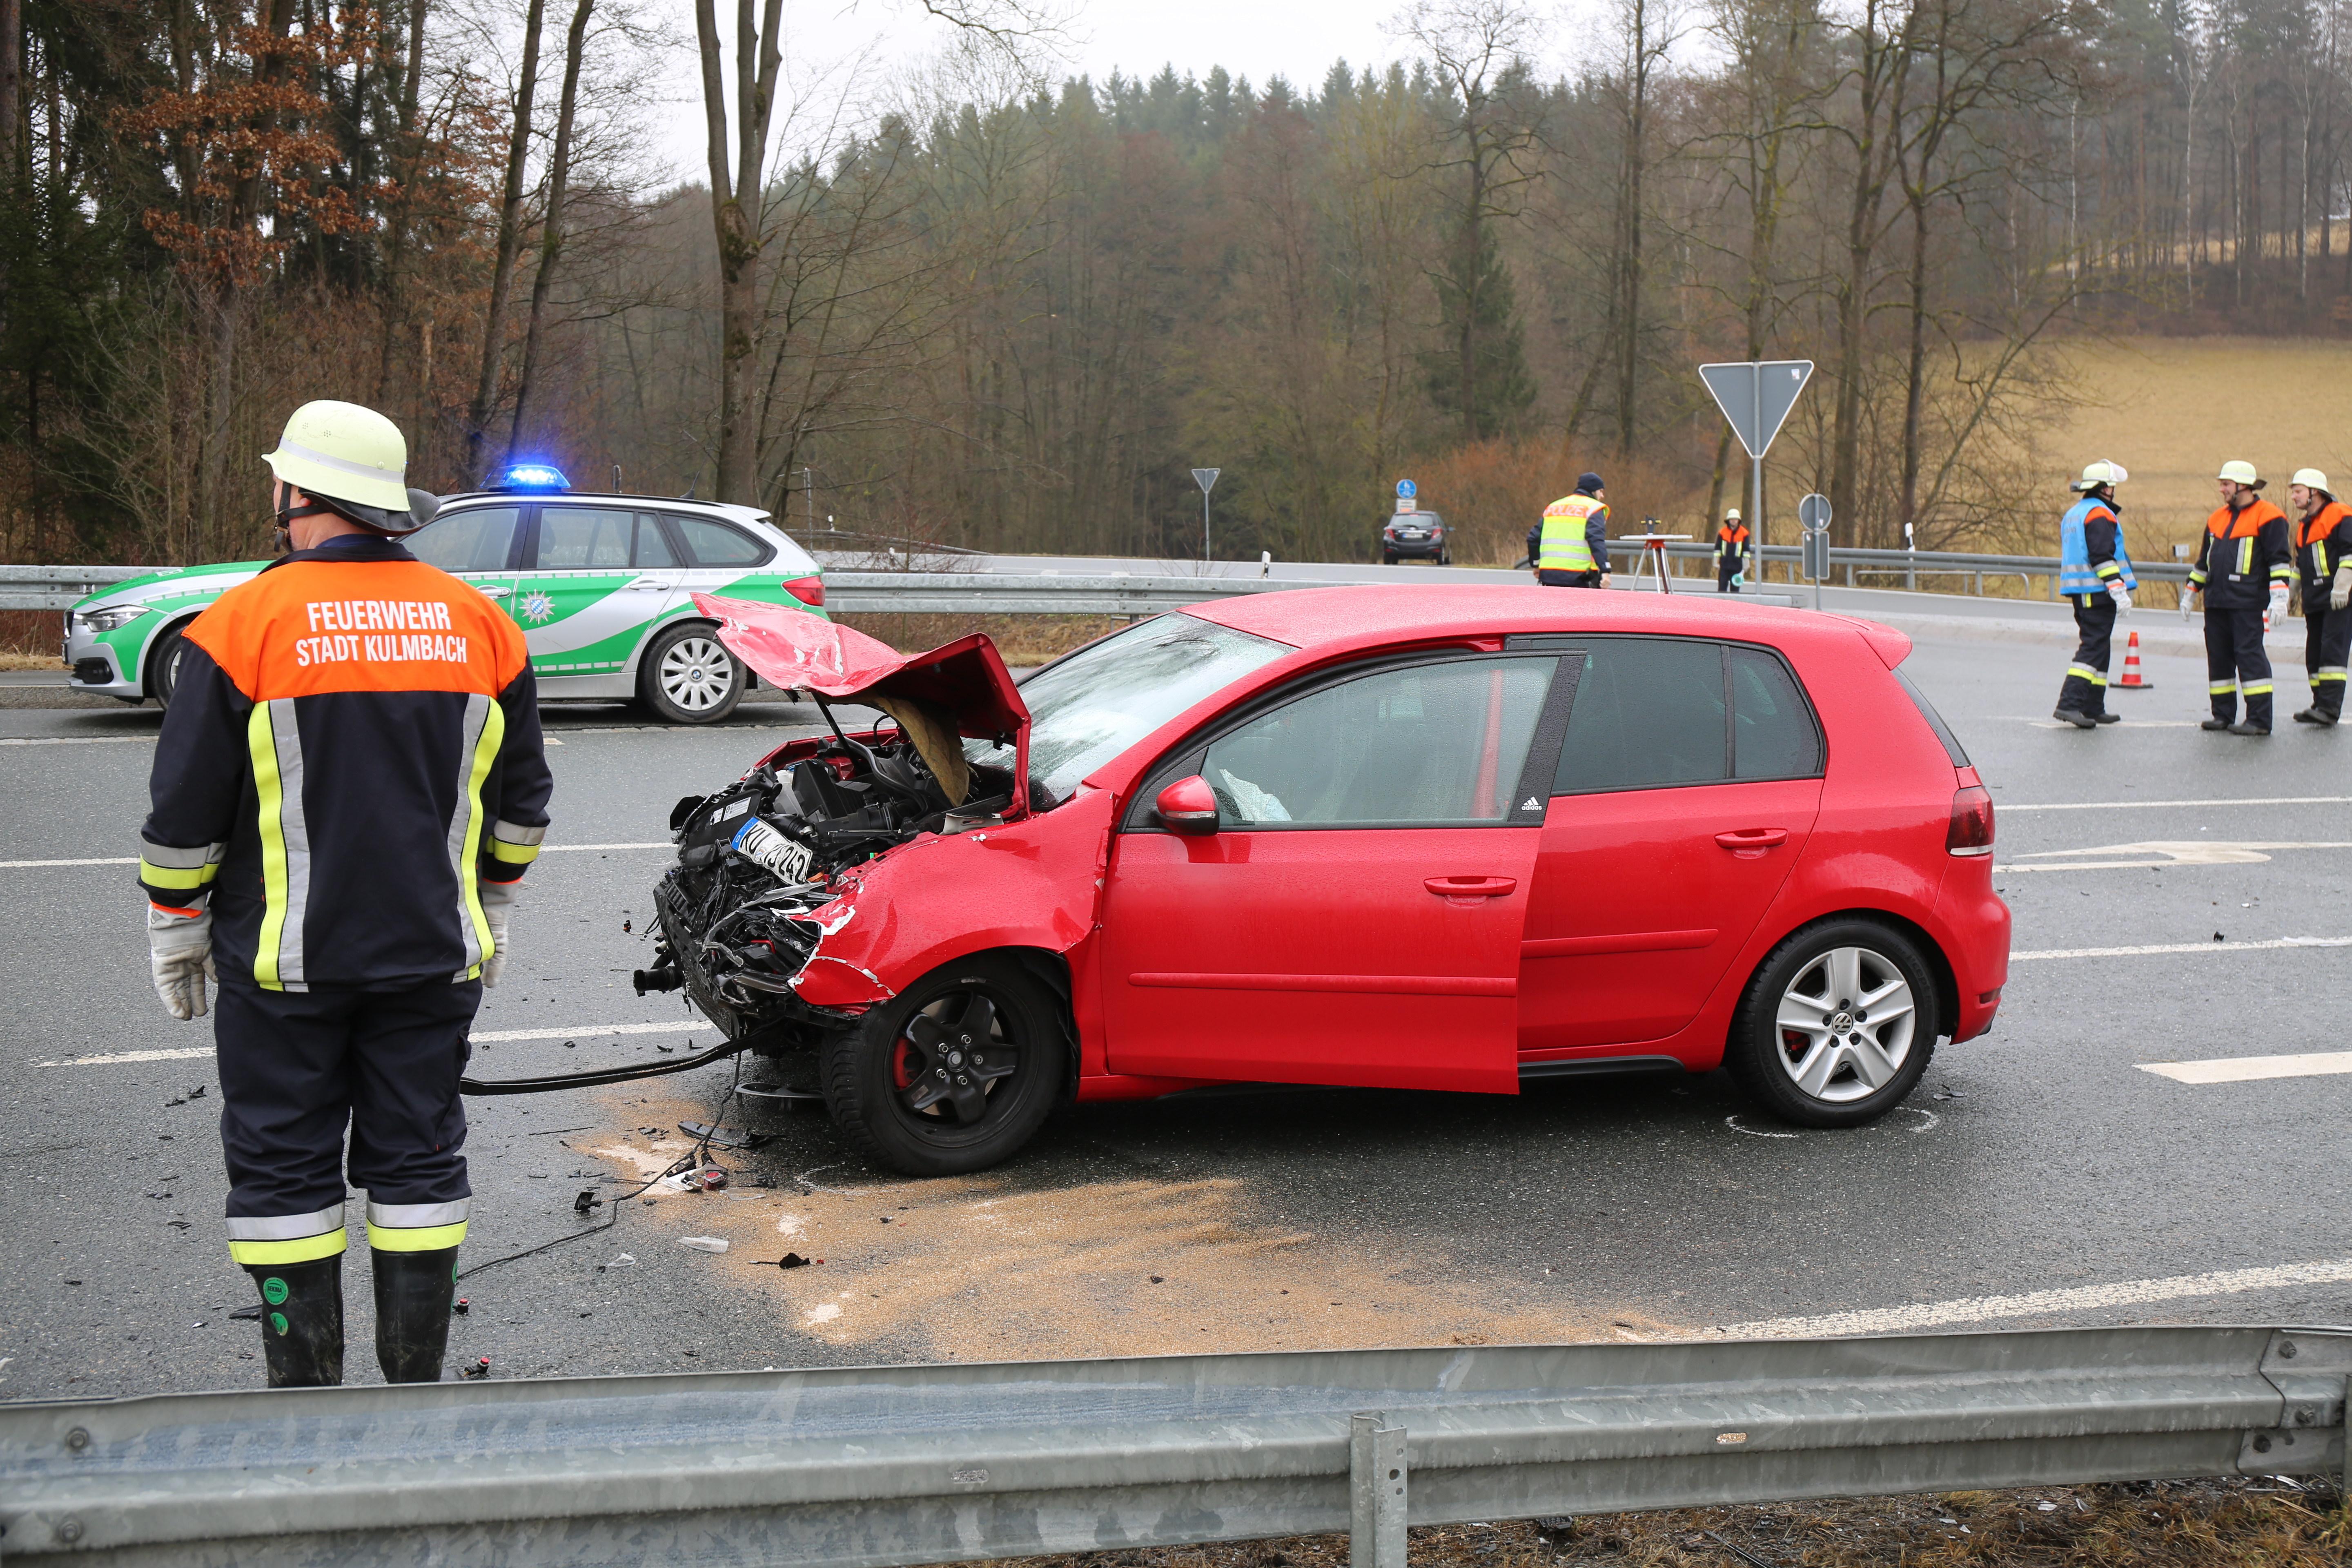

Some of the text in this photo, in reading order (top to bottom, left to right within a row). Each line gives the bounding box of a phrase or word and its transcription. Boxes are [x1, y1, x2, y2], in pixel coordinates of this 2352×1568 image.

[306, 600, 452, 632] FEUERWEHR
[296, 635, 467, 666] STADT KULMBACH
[740, 824, 771, 855] KU
